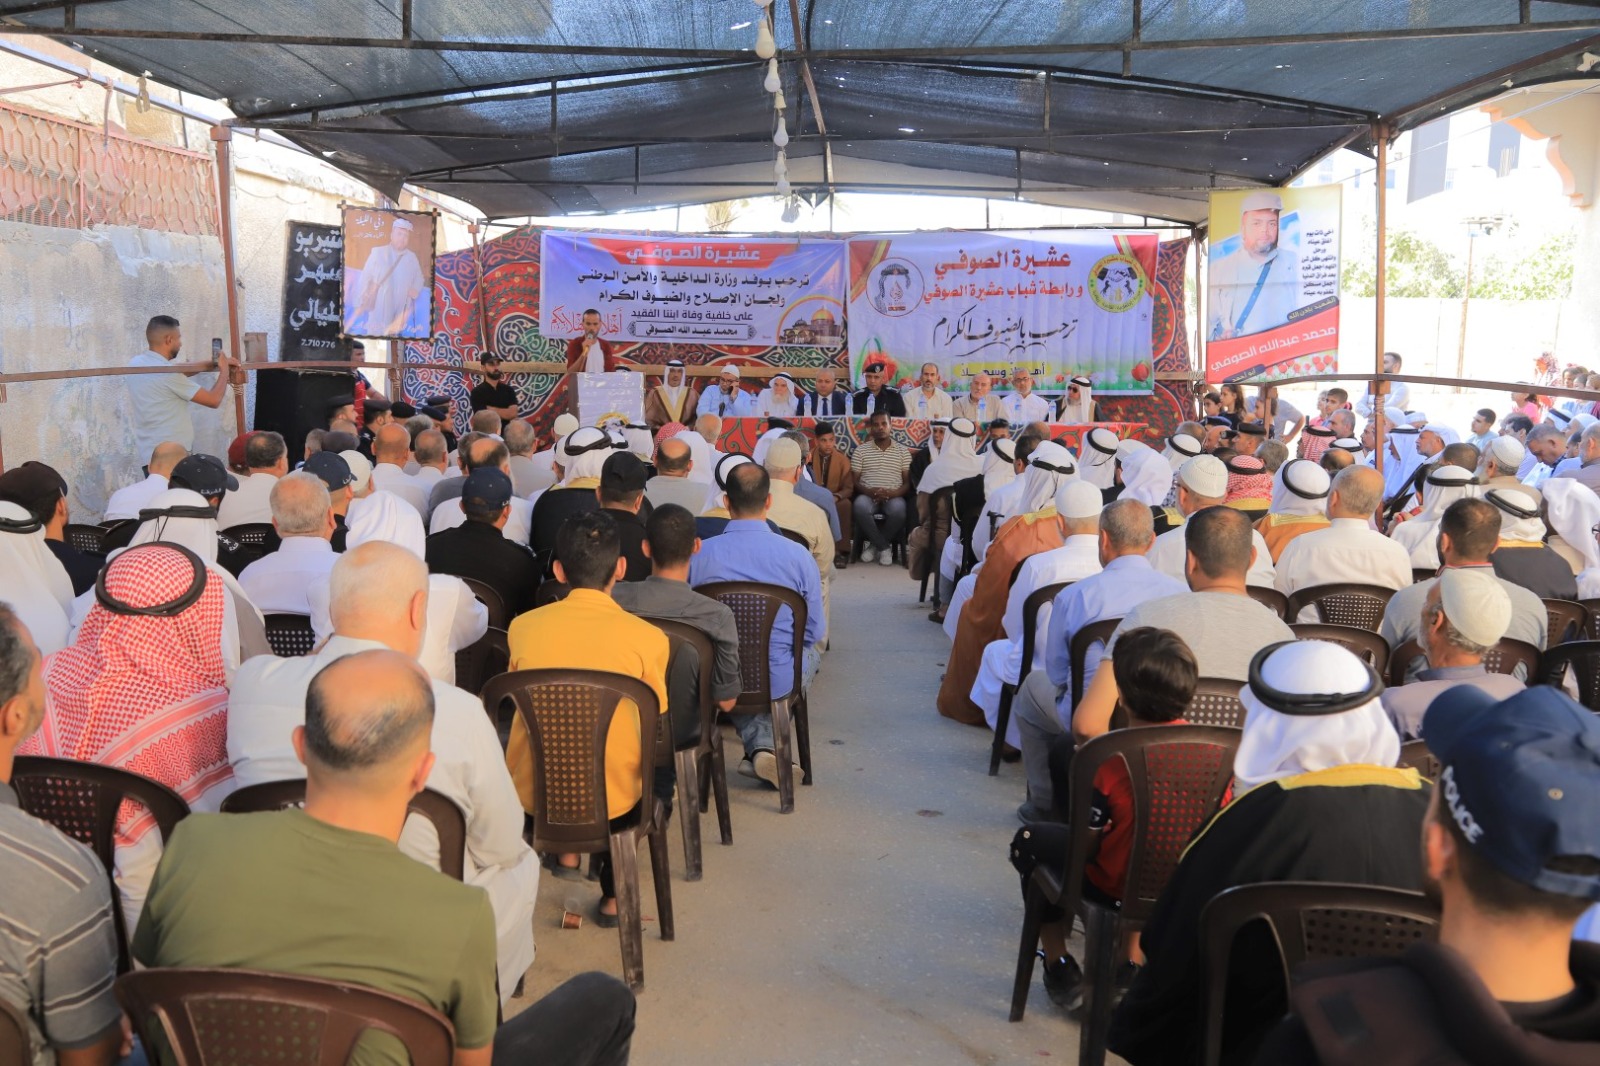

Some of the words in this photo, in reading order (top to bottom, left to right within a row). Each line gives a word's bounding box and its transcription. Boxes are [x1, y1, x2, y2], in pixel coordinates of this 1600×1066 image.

[294, 229, 342, 258] تيريو
[626, 244, 701, 264] الصوفي
[704, 244, 760, 264] عشيرة
[1012, 246, 1072, 275] عشيرة
[935, 249, 1008, 280] الصوفي
[577, 270, 619, 284] الوطني
[661, 270, 711, 285] الداخلية
[714, 272, 738, 287] وزارة
[741, 273, 772, 288] بوفد
[775, 274, 810, 288] ترحب
[599, 289, 639, 303] الكرام
[923, 283, 967, 304] الصوفي
[970, 282, 1004, 301] عشيرة
[1007, 280, 1036, 299] شباب
[641, 290, 691, 306] والضيوف
[744, 293, 785, 307] ولجان
[289, 296, 340, 331] ليالي
[631, 308, 660, 319] الفقيد
[682, 309, 702, 321] وفاة
[705, 311, 731, 321] خلفية
[645, 322, 676, 335] الصوفي
[678, 324, 690, 334] الله
[692, 326, 712, 335] عبد
[713, 327, 738, 336] محمد
[1302, 326, 1337, 341] محمد
[1210, 345, 1257, 372] الصوفي
[1441, 765, 1484, 844] POLICE
